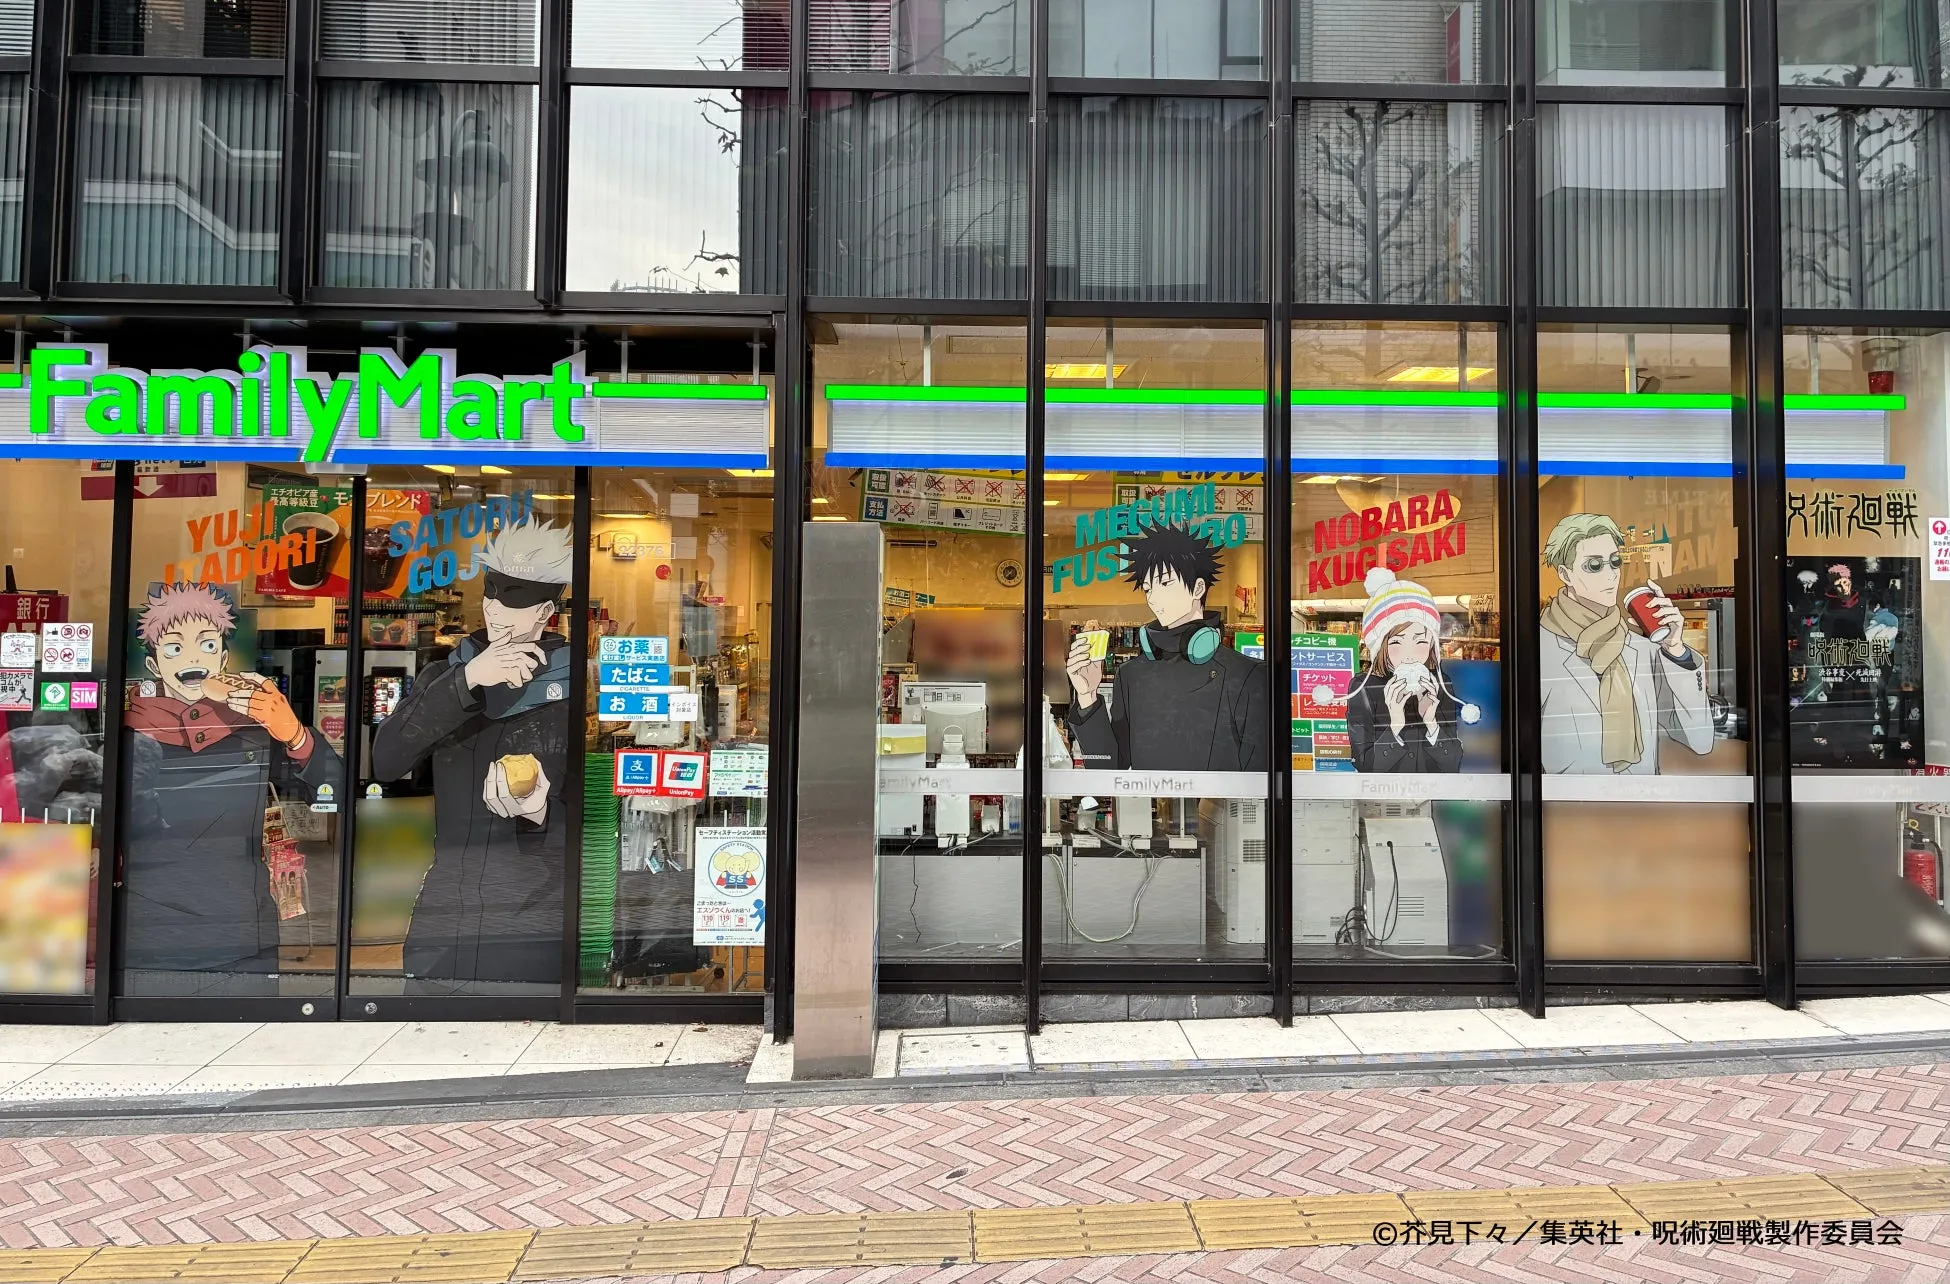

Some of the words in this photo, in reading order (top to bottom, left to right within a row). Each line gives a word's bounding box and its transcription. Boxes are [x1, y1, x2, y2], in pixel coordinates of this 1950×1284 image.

[31, 348, 586, 463] FamilyMart
[333, 491, 422, 510] モブレンド
[1075, 481, 1216, 549] MEGUMI
[1314, 489, 1456, 554] NOBARA
[1787, 491, 1920, 540] 呪術廻戦
[186, 500, 276, 555] YUJI
[164, 527, 317, 587] ITADORI
[1308, 522, 1467, 594] KUGISAKI
[17, 597, 50, 620] 銀行
[618, 640, 649, 654] お薬
[1291, 636, 1337, 646] チコピー機
[1807, 638, 1892, 667] 呪術廻戦
[611, 667, 659, 684] たばこ
[1303, 673, 1336, 682] チケット
[72, 693, 97, 703] SIM
[668, 789, 695, 798] UnionPay
[1113, 776, 1195, 792] FamilyMart
[728, 875, 744, 884] SS
